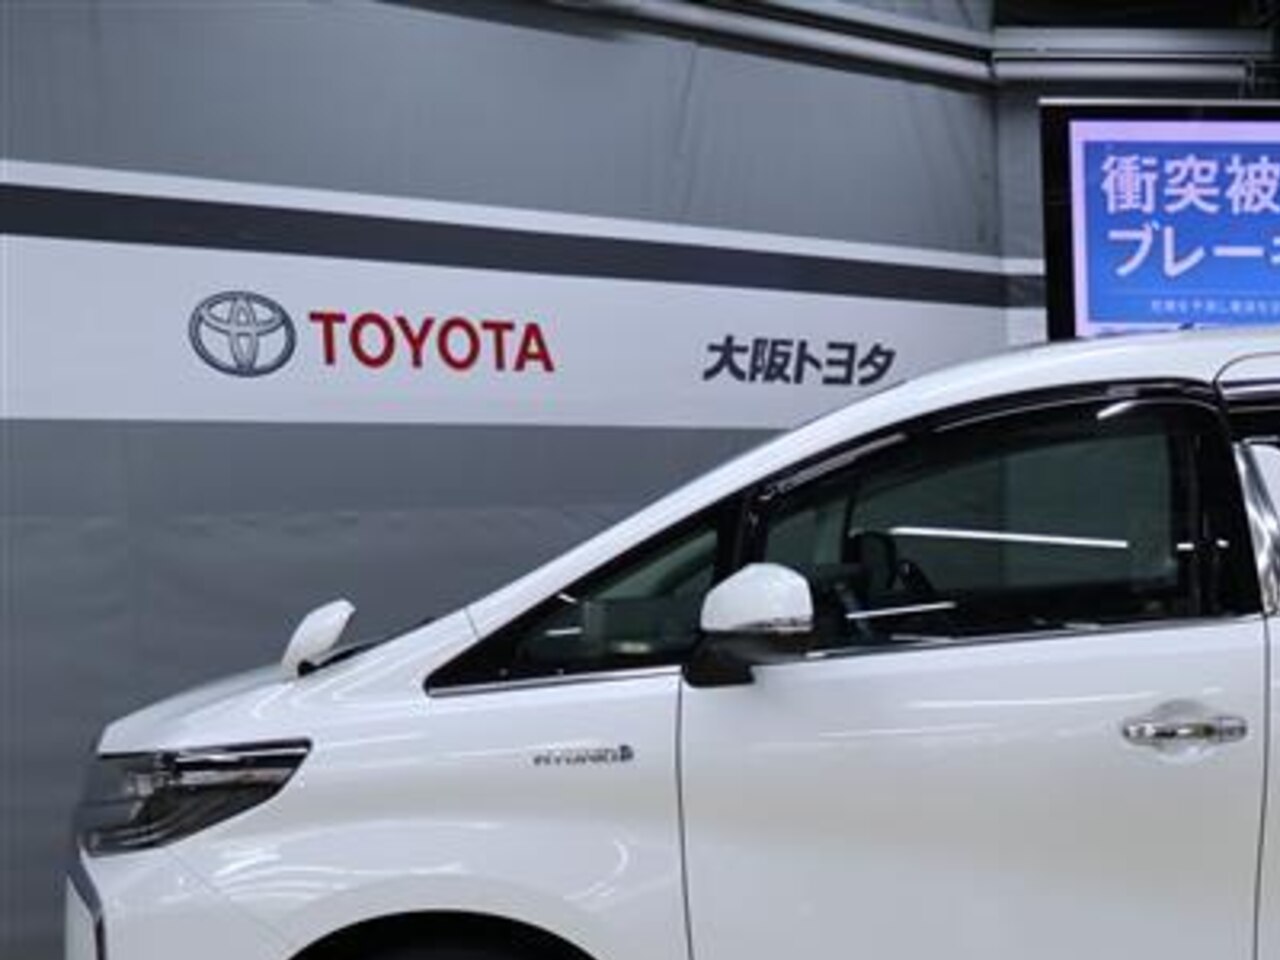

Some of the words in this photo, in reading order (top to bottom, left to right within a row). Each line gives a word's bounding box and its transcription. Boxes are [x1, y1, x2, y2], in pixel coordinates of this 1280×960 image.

[309, 312, 555, 373] TOYOTA
[703, 335, 896, 386] 大阪トヨタ
